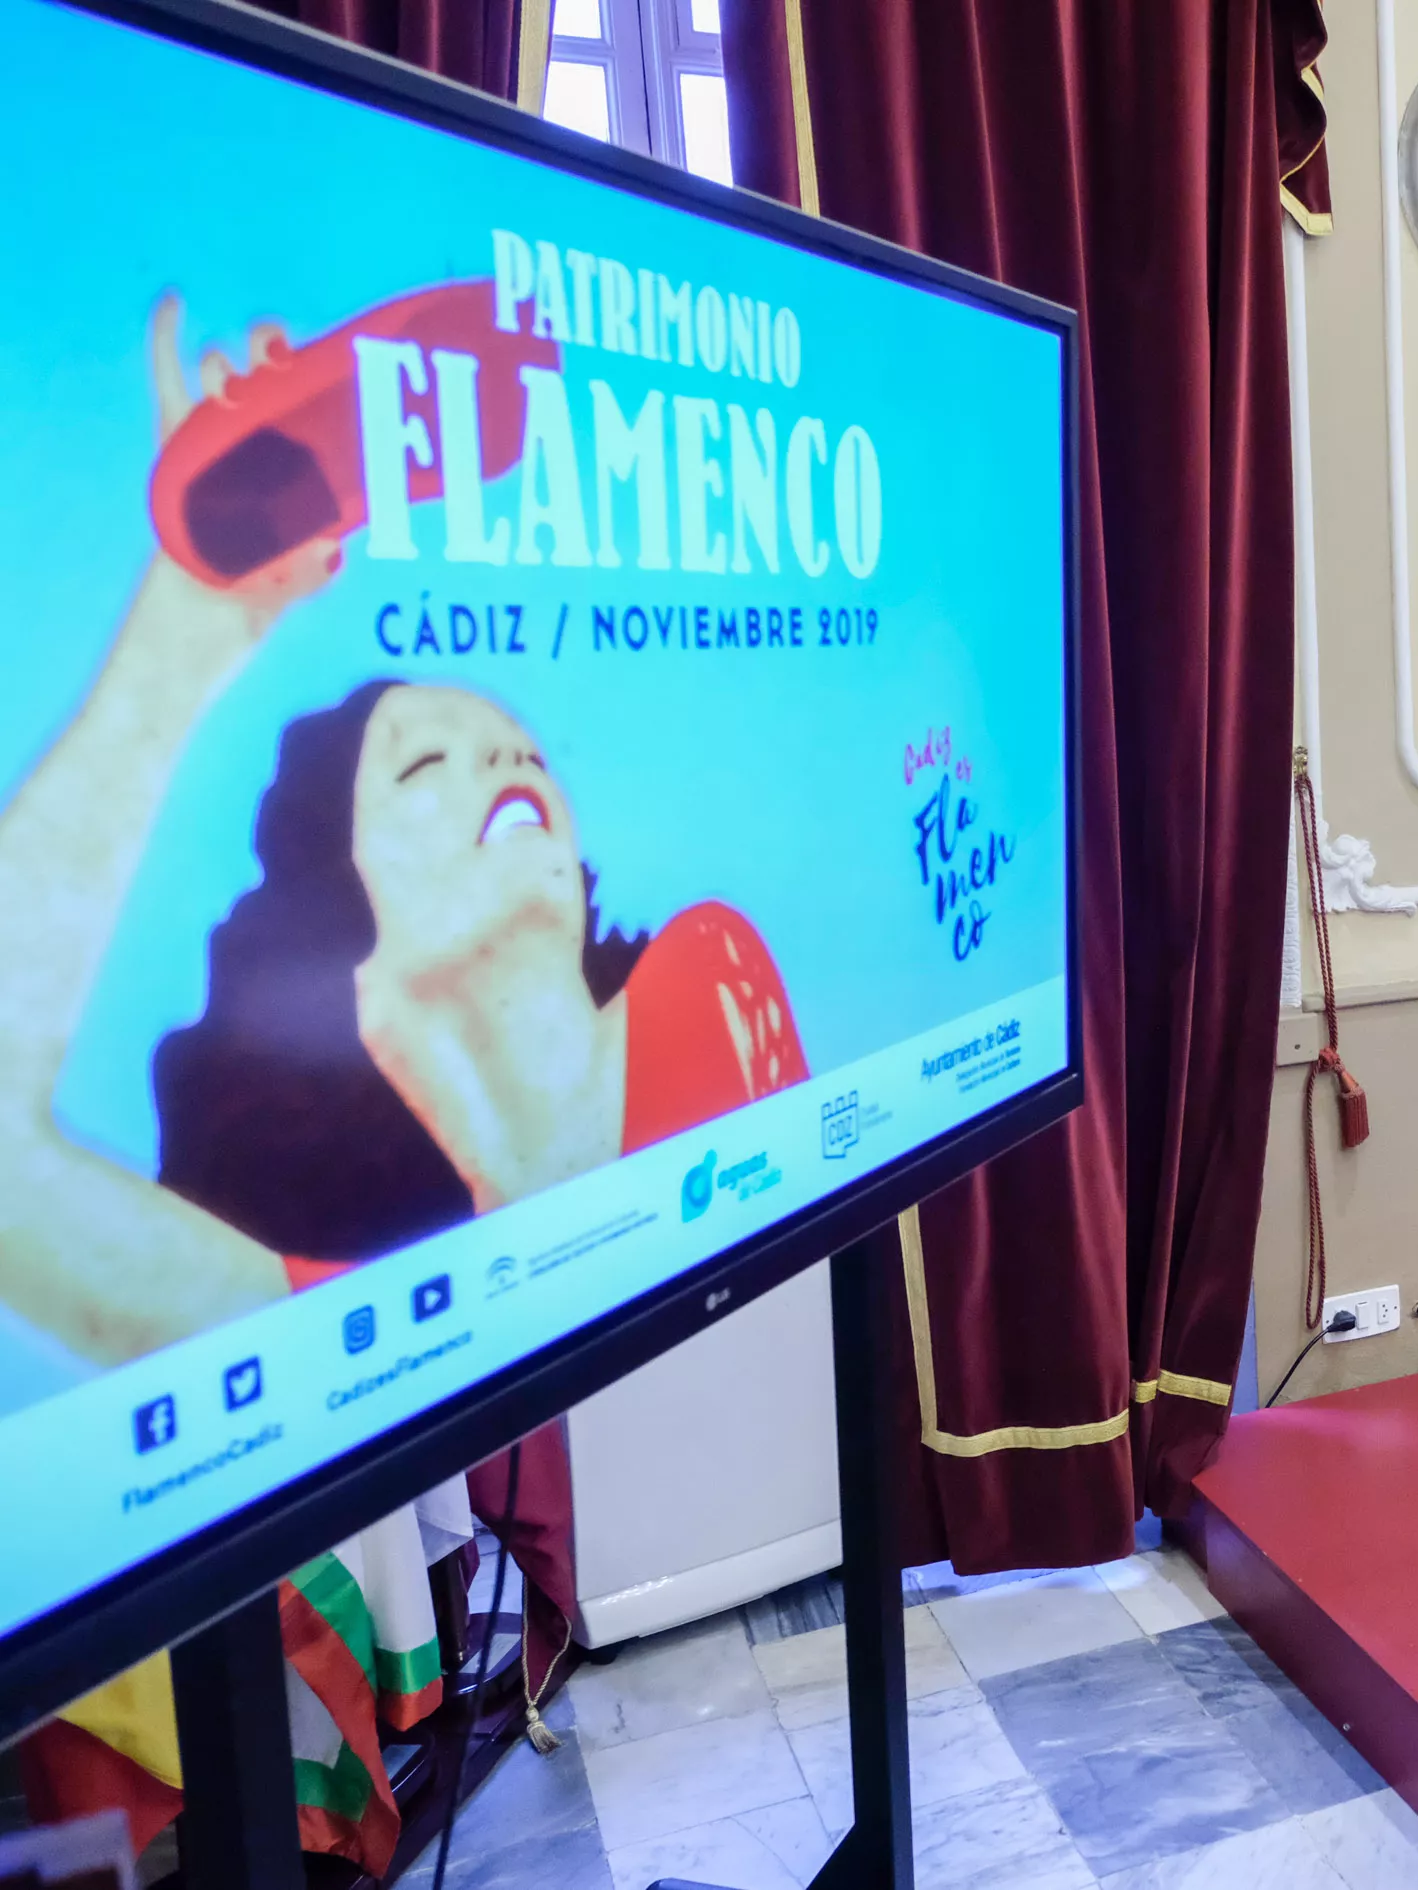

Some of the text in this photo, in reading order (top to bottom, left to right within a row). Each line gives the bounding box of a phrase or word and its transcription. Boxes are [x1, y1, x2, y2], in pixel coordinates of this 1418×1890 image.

[492, 228, 802, 389] PATRIMONIO
[352, 334, 883, 580] FLAMENCO
[374, 590, 528, 657] CÁDIZ
[592, 603, 804, 651] NOVIEMBRE
[818, 605, 880, 647] 2019
[920, 1036, 982, 1084] Ayuntamiento
